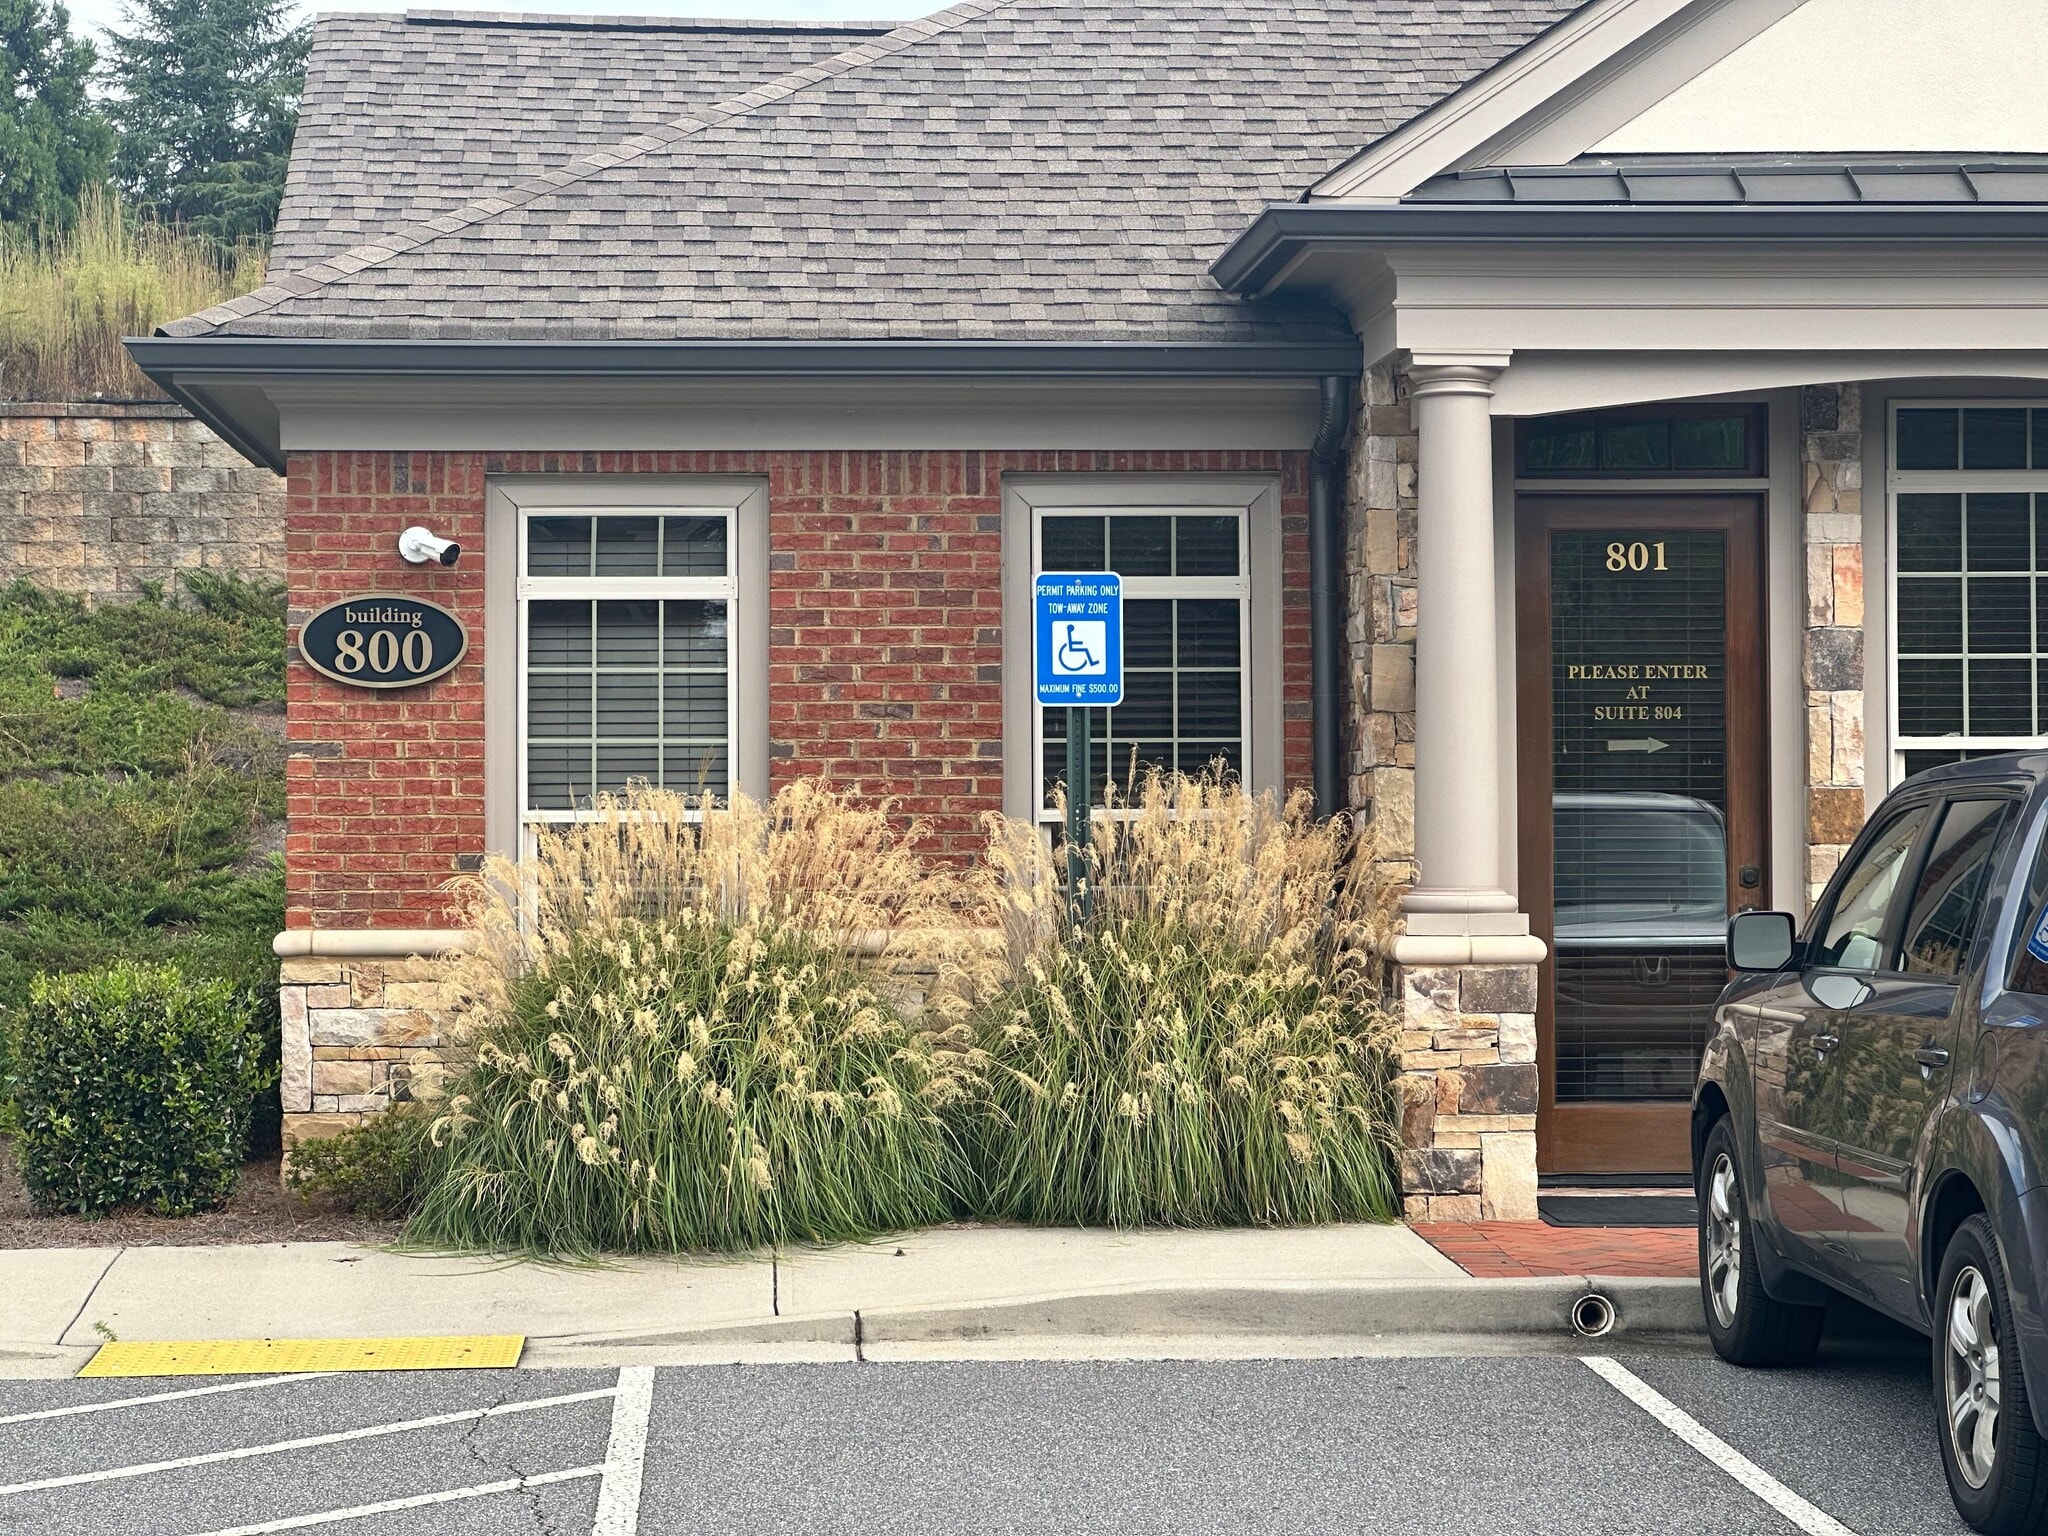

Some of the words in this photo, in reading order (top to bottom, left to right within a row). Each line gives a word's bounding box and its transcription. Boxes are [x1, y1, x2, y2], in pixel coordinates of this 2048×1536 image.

[1605, 541, 1669, 572] 801
[1037, 585, 1063, 596] PERMIT
[1066, 584, 1097, 596] PARKING
[1100, 585, 1119, 596] ONLY
[1048, 603, 1085, 614] TOW-AWAY
[1088, 603, 1108, 614] ZONE
[345, 607, 422, 628] building
[334, 630, 433, 674] 800
[1568, 665, 1639, 679] PLEASE
[1645, 665, 1708, 679] ENTER
[1040, 683, 1070, 693] MAXIMUM
[1072, 683, 1086, 693] FINE
[1088, 683, 1119, 694] $500.00
[1626, 685, 1650, 699] AT
[1594, 706, 1649, 720] SUITE
[1654, 706, 1682, 720] 804
